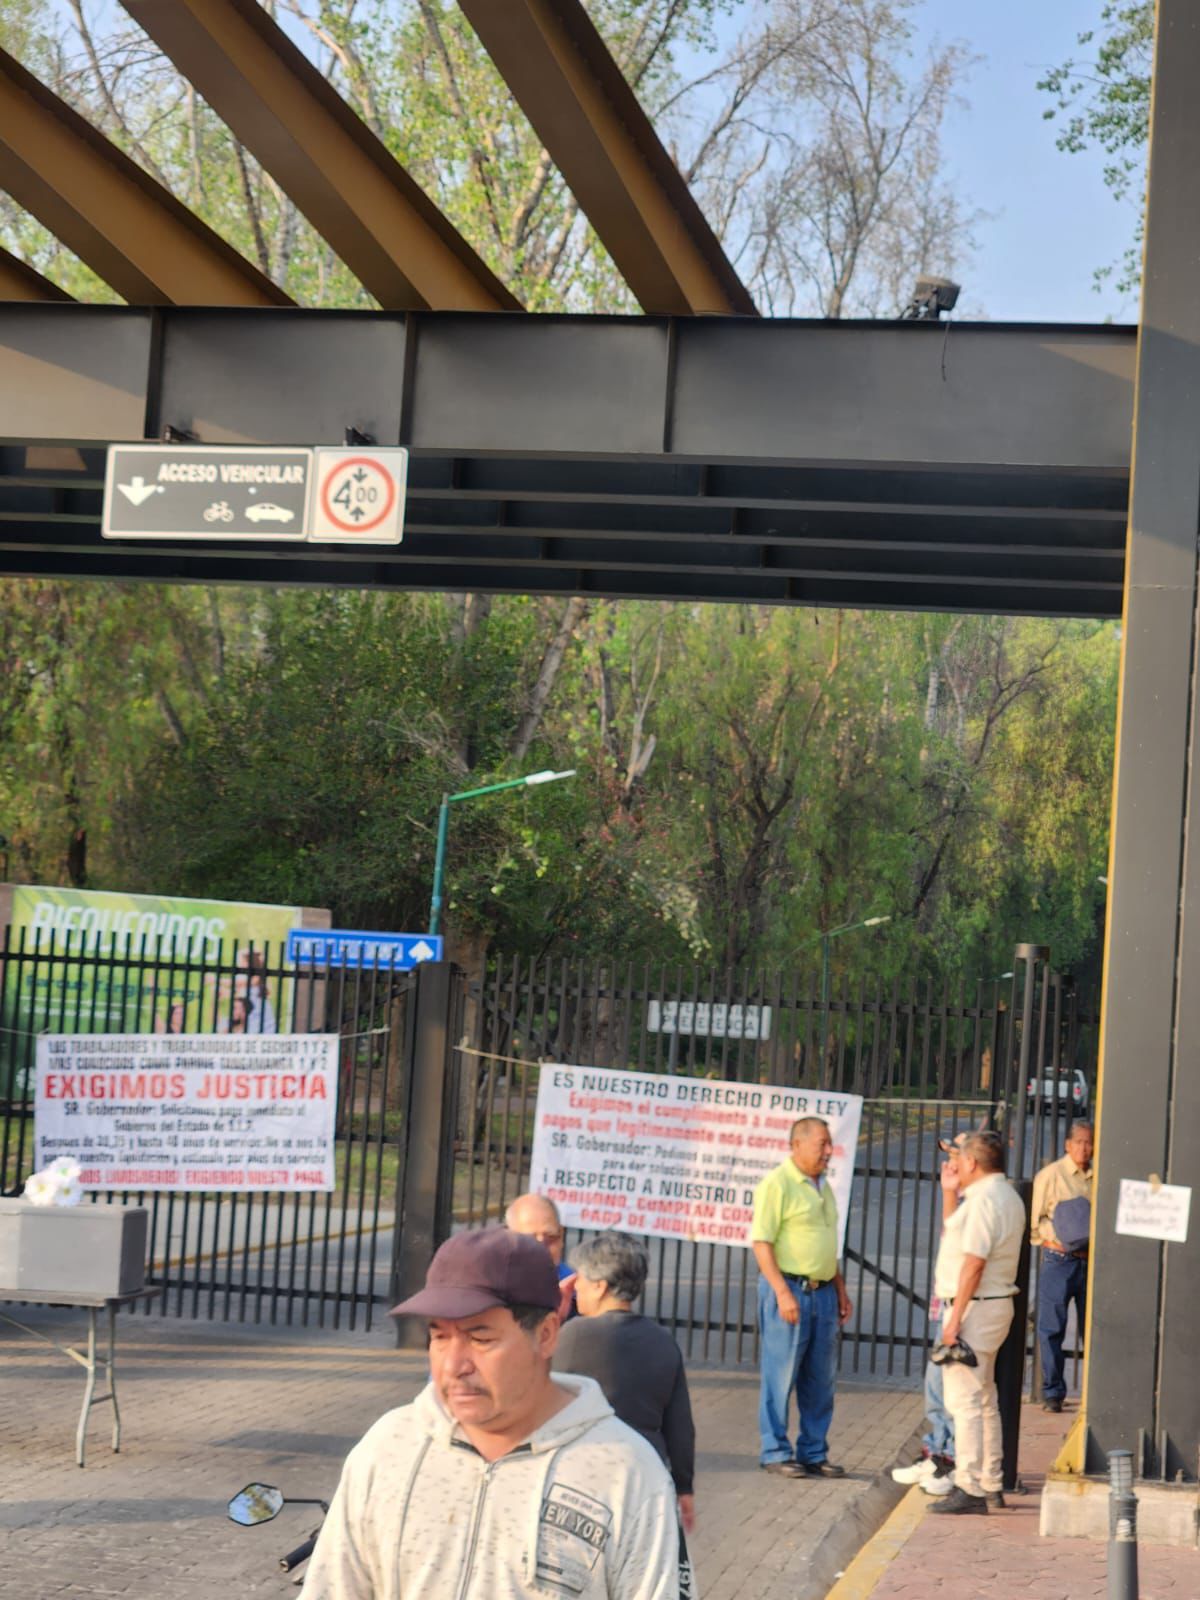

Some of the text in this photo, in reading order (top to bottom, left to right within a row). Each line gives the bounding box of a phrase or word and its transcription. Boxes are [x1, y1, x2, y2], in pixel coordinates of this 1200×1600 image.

[157, 463, 304, 484] ACCESO VEHICULAR
[45, 1074, 327, 1099] EXIGIMOS JUSTICIA
[553, 1072, 848, 1117] ES NUESTRO DERECHO POR LEY
[569, 1091, 633, 1113] Exigimos
[638, 1100, 650, 1115] el
[655, 1103, 748, 1127] cumplimiento
[551, 1133, 571, 1148] SR.
[576, 1135, 650, 1155] Gobernador:
[555, 1169, 636, 1192] RESPECTO
[642, 1178, 652, 1196] A
[659, 1180, 736, 1204] NUESTRO
[628, 1213, 647, 1229] DE
[637, 1197, 716, 1218] CUMPLAN
[721, 1206, 753, 1223] CON
[543, 1503, 570, 1526] EW
